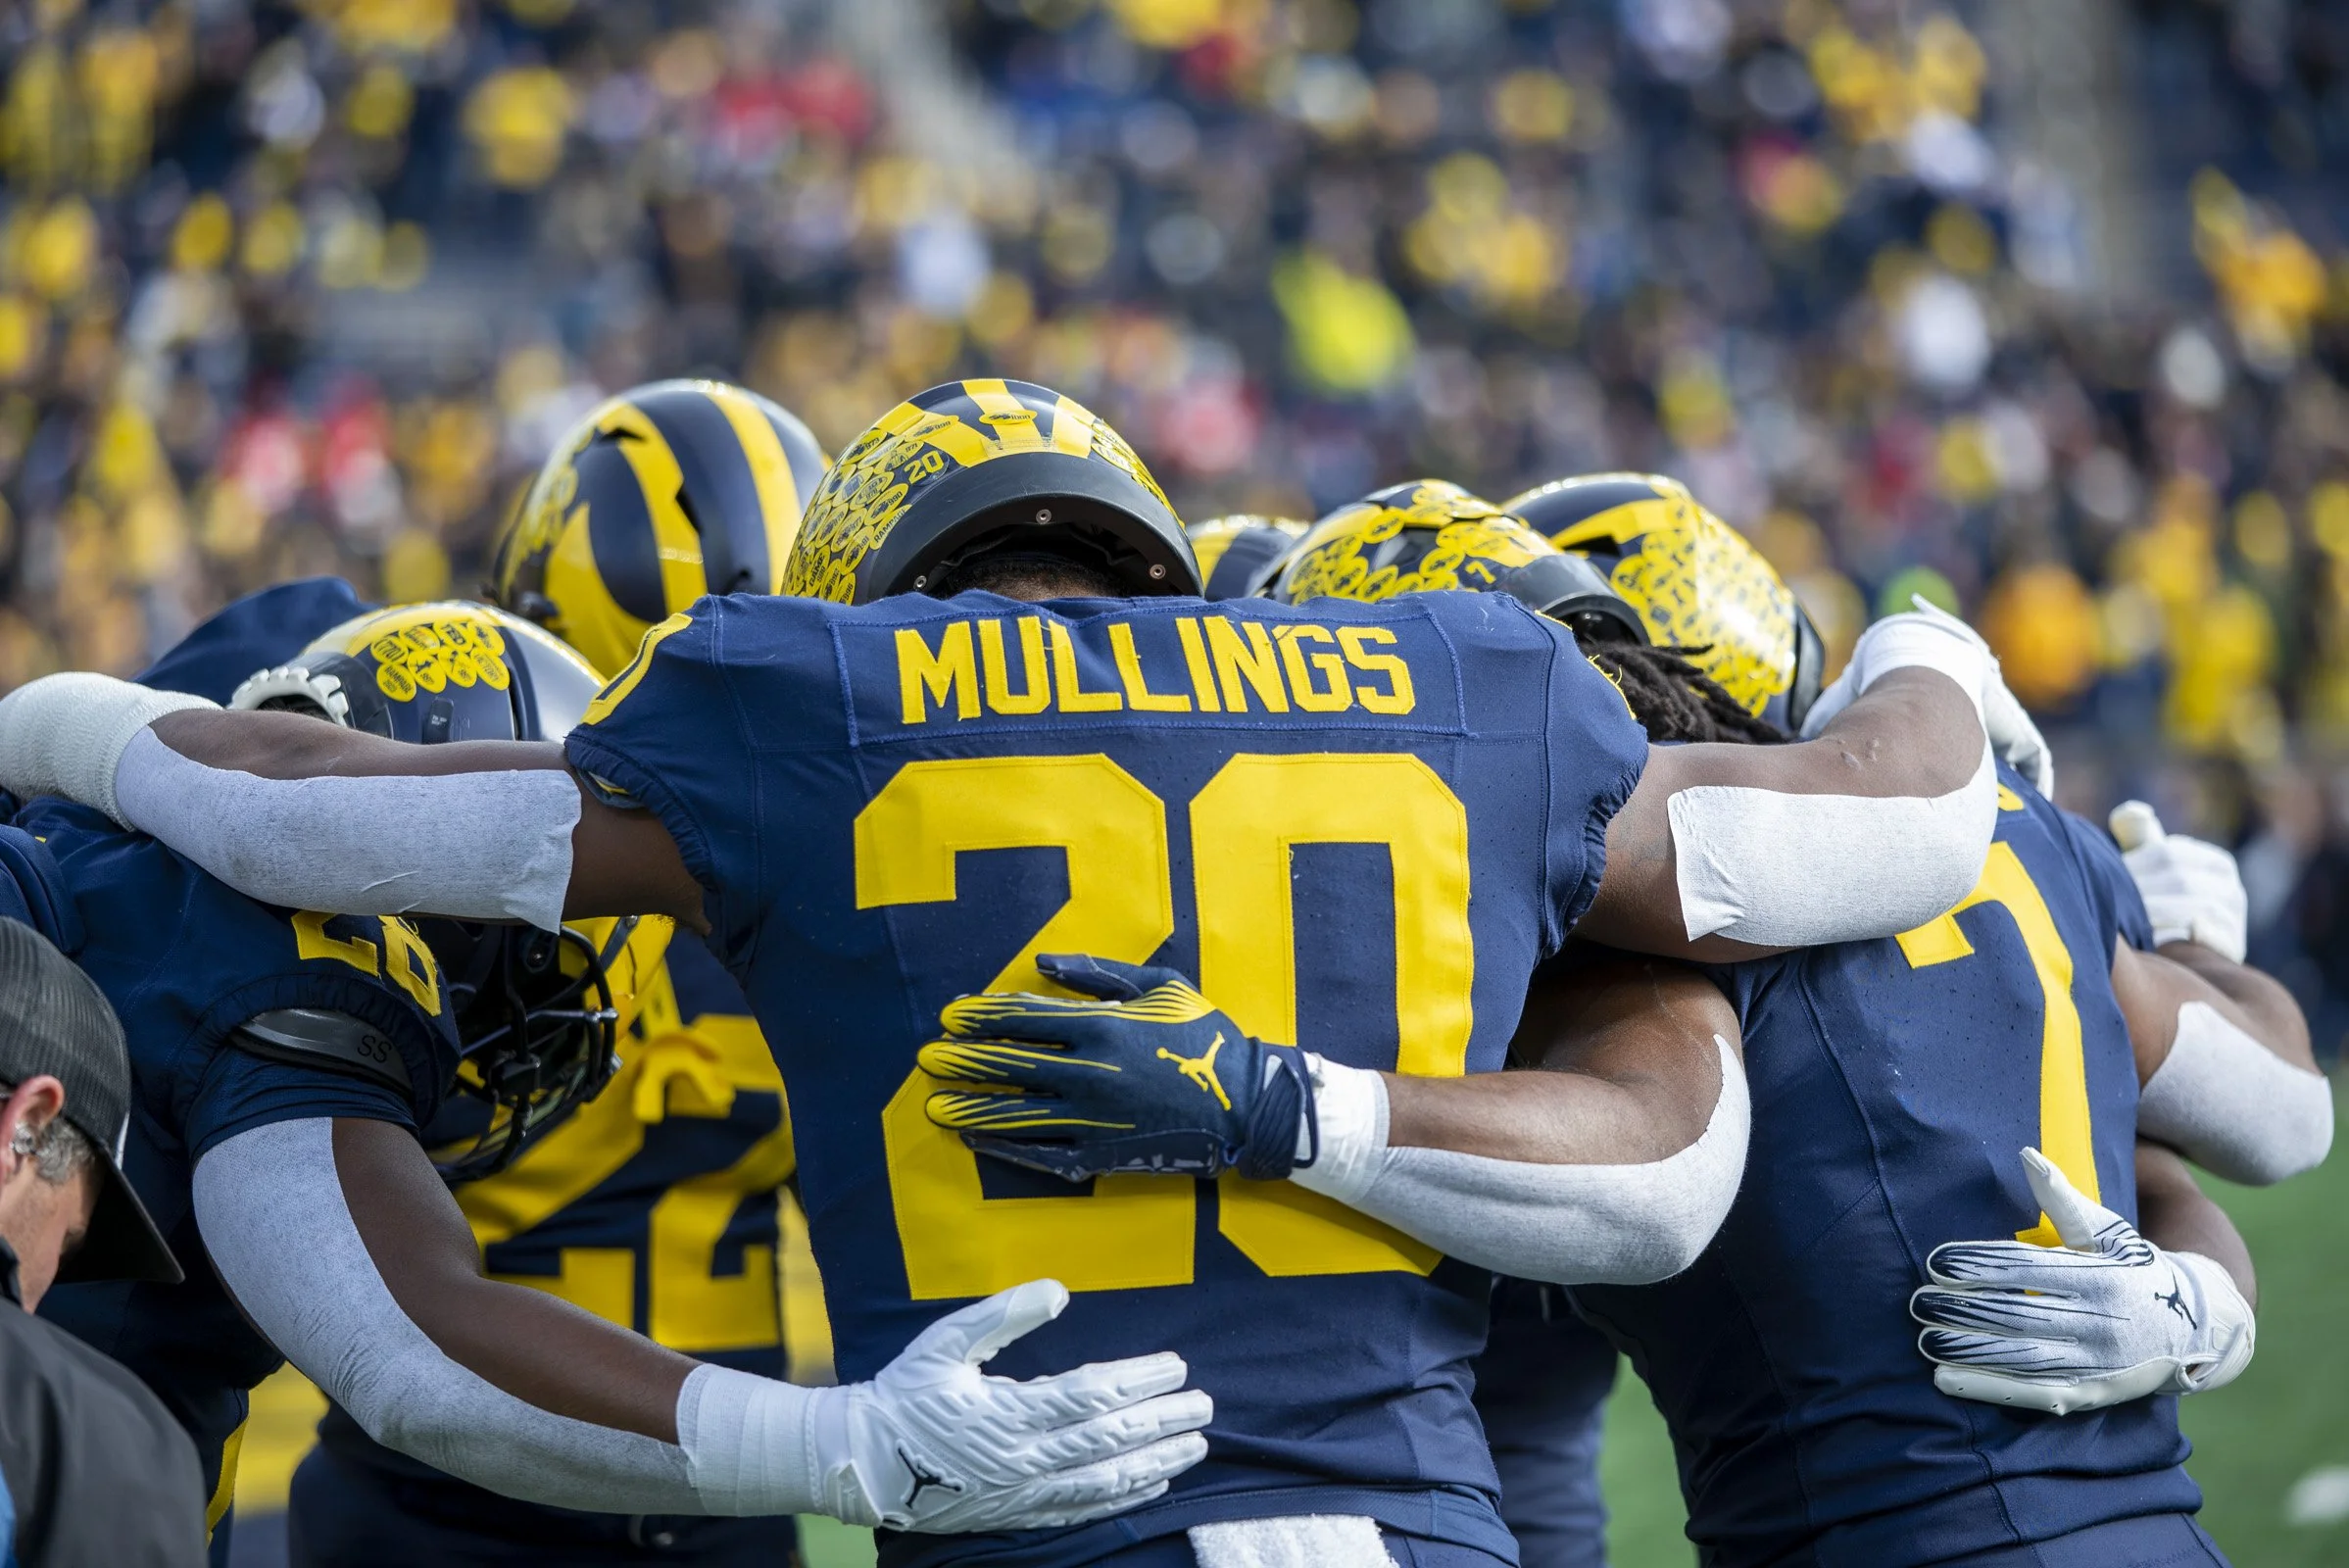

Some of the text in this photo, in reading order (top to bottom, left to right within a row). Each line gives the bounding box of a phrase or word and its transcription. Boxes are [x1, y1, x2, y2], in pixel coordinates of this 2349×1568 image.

[904, 450, 945, 485] 20
[1465, 561, 1496, 584] 7
[895, 615, 1415, 723] MULLINGS
[358, 1035, 392, 1062] SS
[854, 753, 1474, 1300] 20
[1894, 841, 2100, 1295] 7
